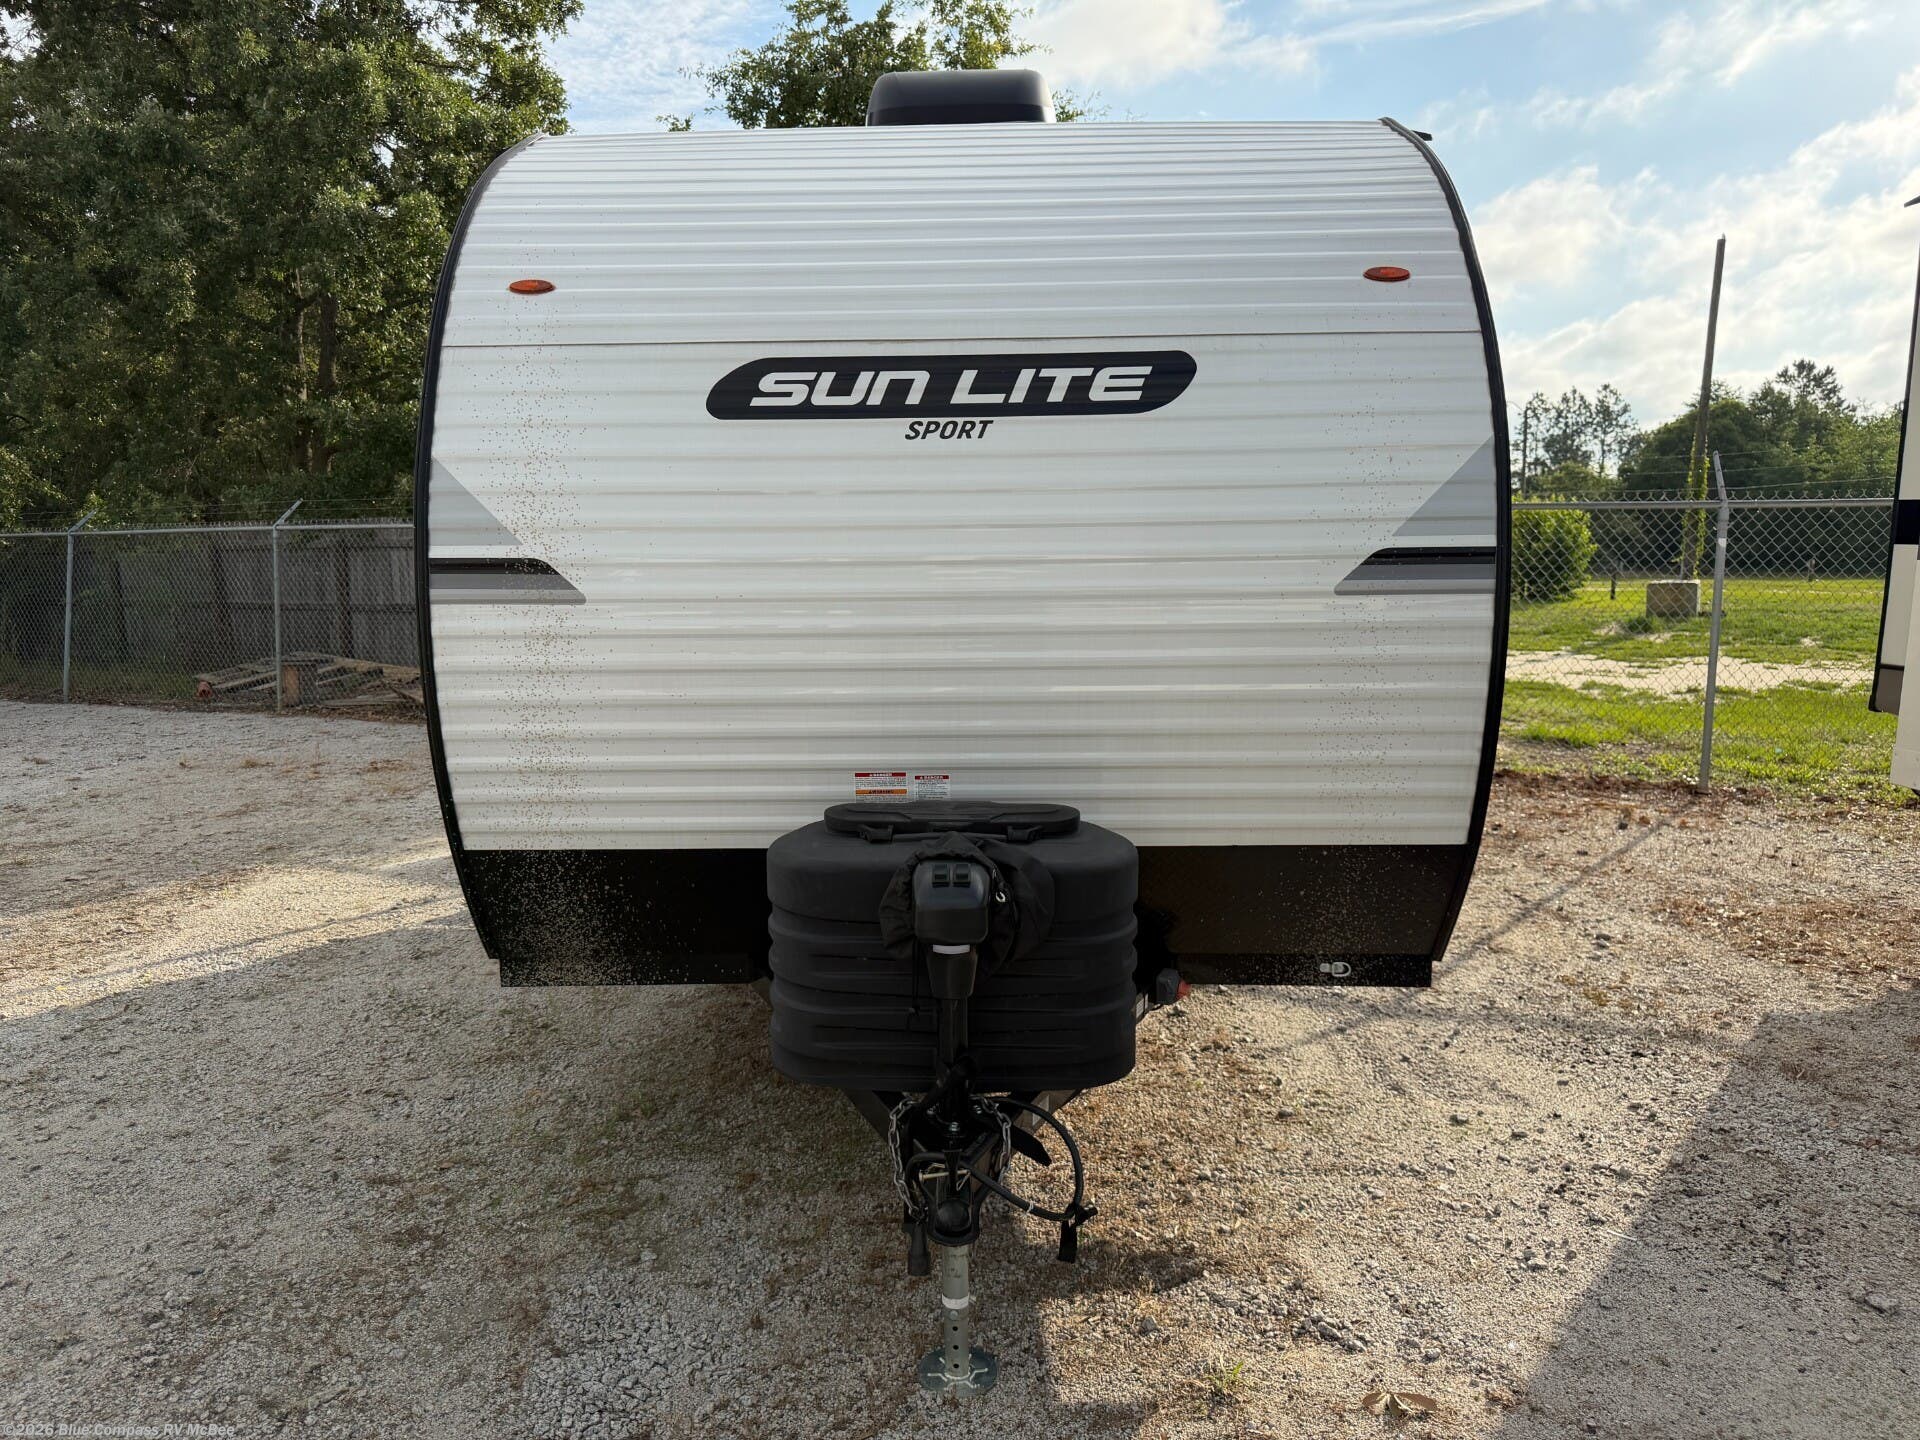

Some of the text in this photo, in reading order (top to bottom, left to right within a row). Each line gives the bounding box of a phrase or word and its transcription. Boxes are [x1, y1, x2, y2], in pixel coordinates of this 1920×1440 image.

[749, 366, 1153, 407] SUN LITE
[904, 419, 995, 441] SPORT
